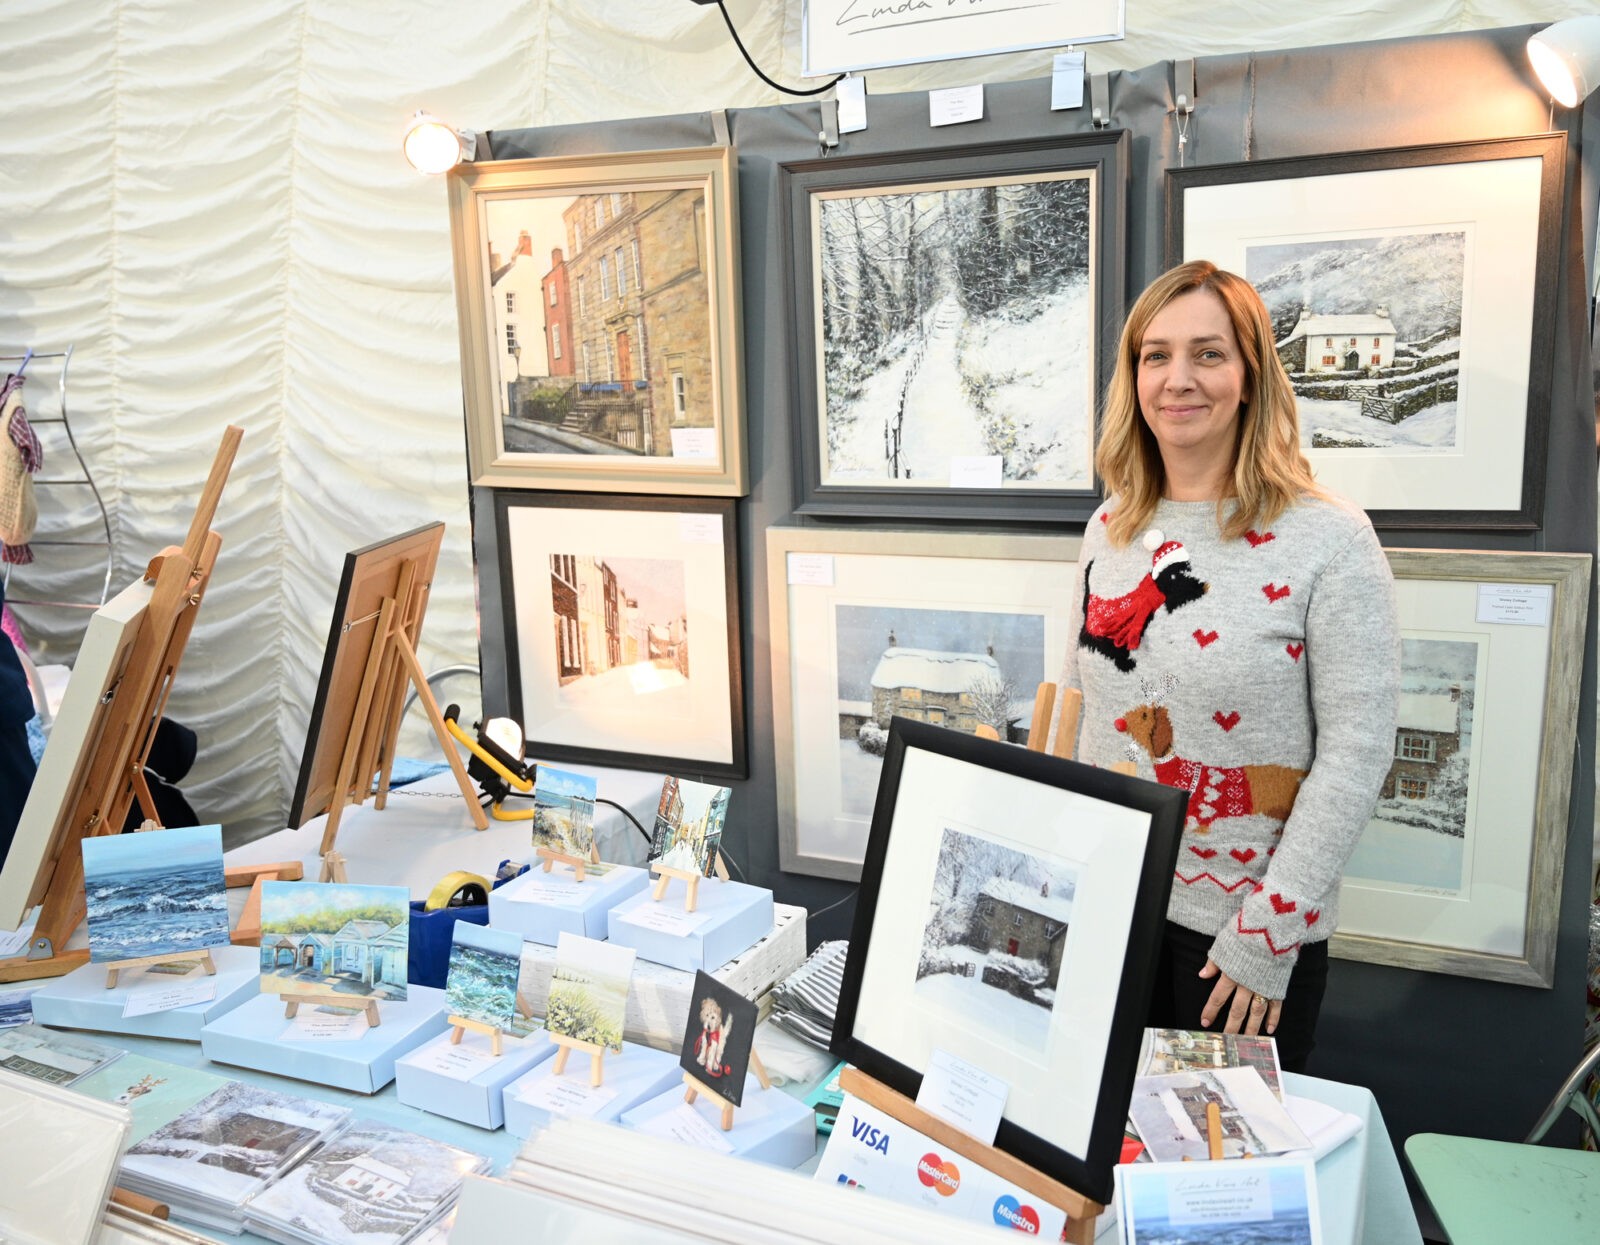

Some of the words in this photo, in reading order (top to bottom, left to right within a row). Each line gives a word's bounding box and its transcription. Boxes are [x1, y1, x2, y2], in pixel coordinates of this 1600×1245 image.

[852, 1115, 890, 1155] VISA
[918, 1160, 959, 1189] MasterCard
[997, 1204, 1035, 1233] Maestro
